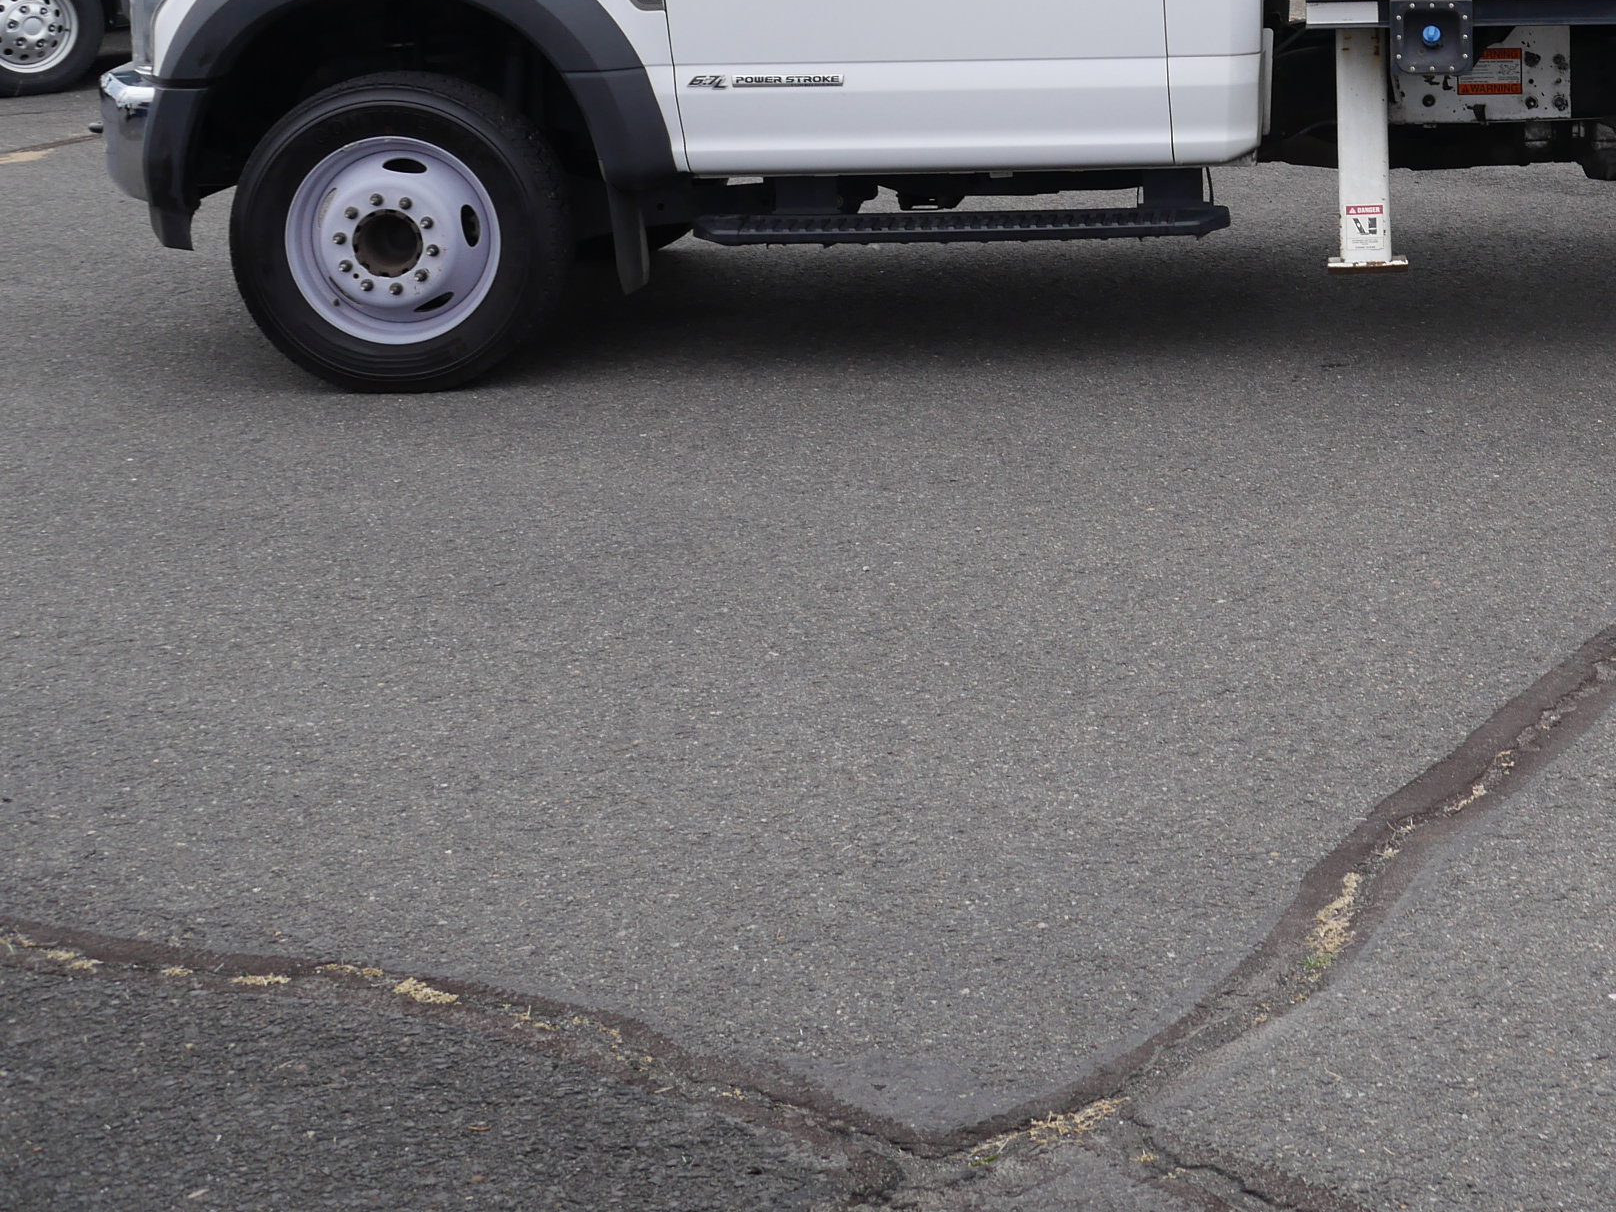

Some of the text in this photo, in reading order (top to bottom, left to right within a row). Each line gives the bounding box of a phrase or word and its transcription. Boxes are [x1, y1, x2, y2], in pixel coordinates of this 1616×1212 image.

[785, 75, 839, 83] STROKE
[1470, 83, 1519, 93] WARNING
[1356, 206, 1381, 214] DANGER
